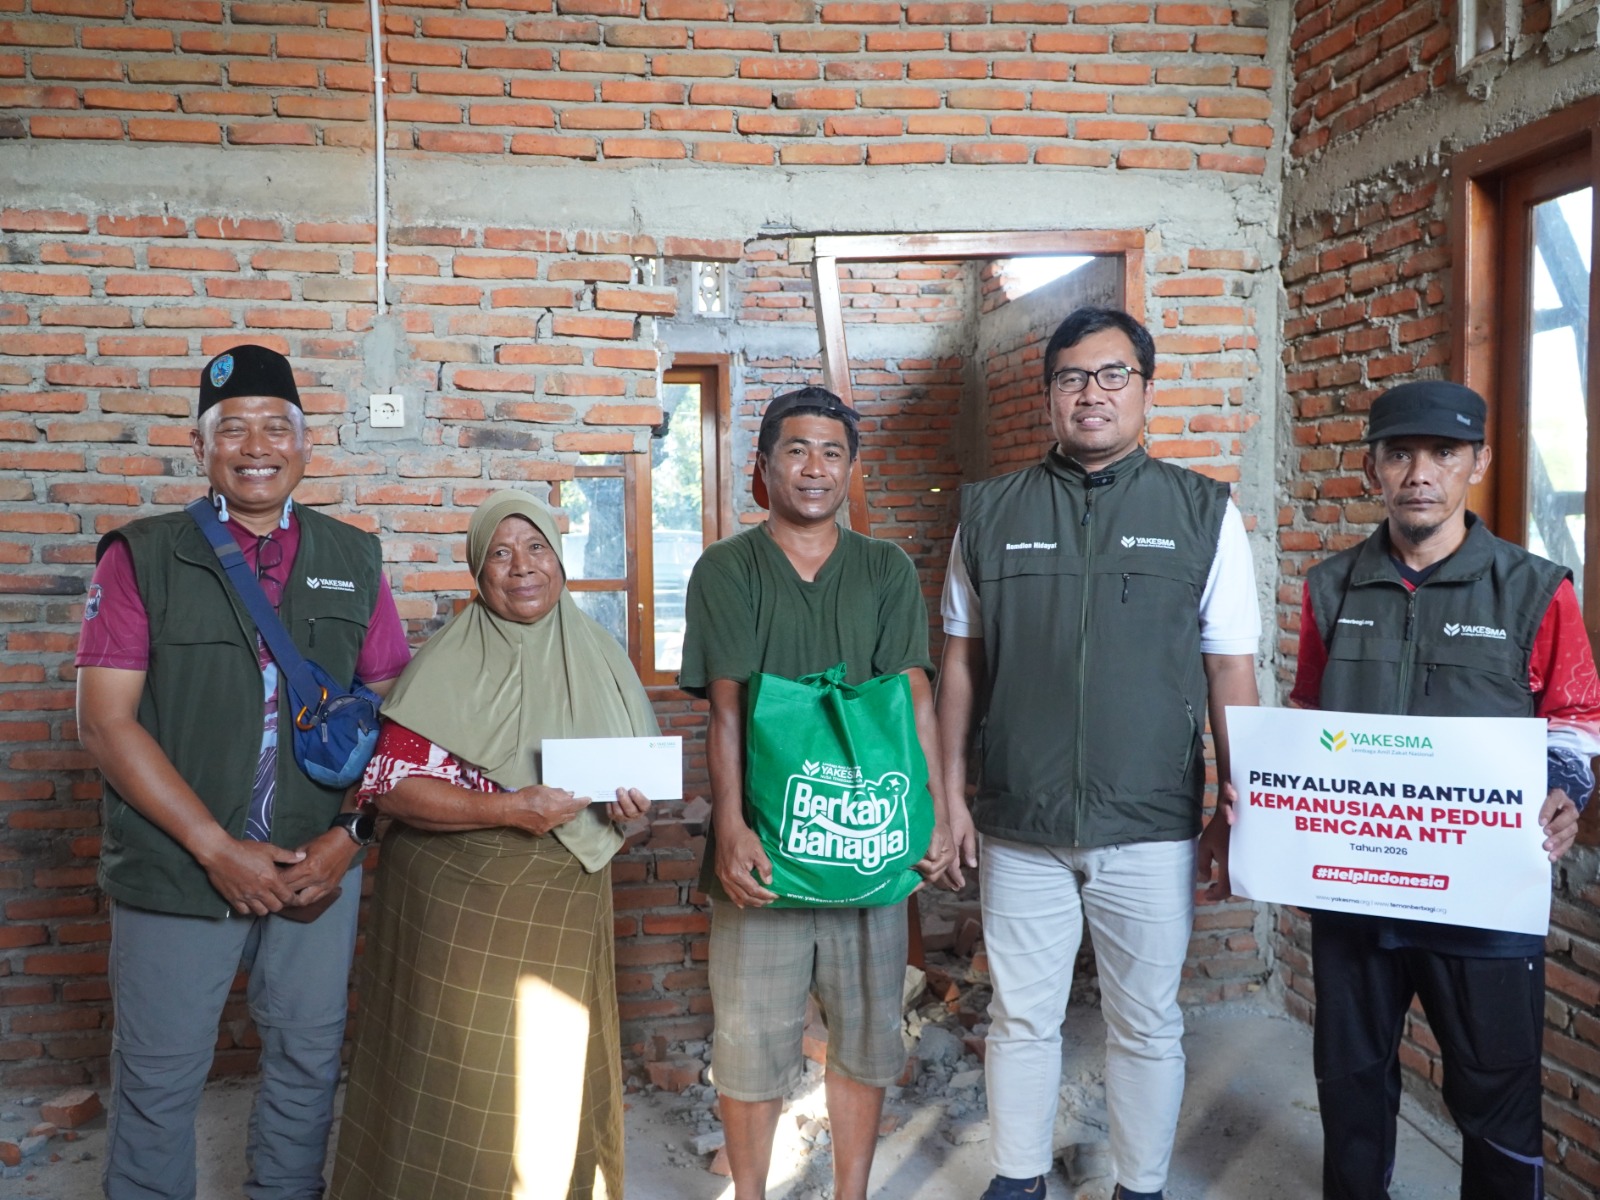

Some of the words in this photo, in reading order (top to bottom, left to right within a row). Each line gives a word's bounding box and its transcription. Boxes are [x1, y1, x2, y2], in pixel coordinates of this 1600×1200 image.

[1135, 537, 1175, 547] YAKESMA
[319, 578, 355, 588] YAKESMA
[1461, 625, 1506, 636] YAKESMA
[1350, 732, 1433, 750] YAKESMA
[821, 766, 863, 779] YAKESA
[1249, 770, 1396, 798] PENYALURAN
[1401, 783, 1523, 805] BANTUAN
[793, 782, 891, 826] Berkah
[1249, 791, 1424, 822] KEMANUSIAAN
[1431, 806, 1523, 829] PEDULI
[1295, 816, 1412, 842] BENCANA
[1419, 827, 1467, 845] NTT
[787, 819, 904, 868] Bahagia
[1349, 843, 1383, 854] Tahun
[1384, 846, 1408, 856] 2026
[1316, 867, 1446, 889] #HelpIndonesia
